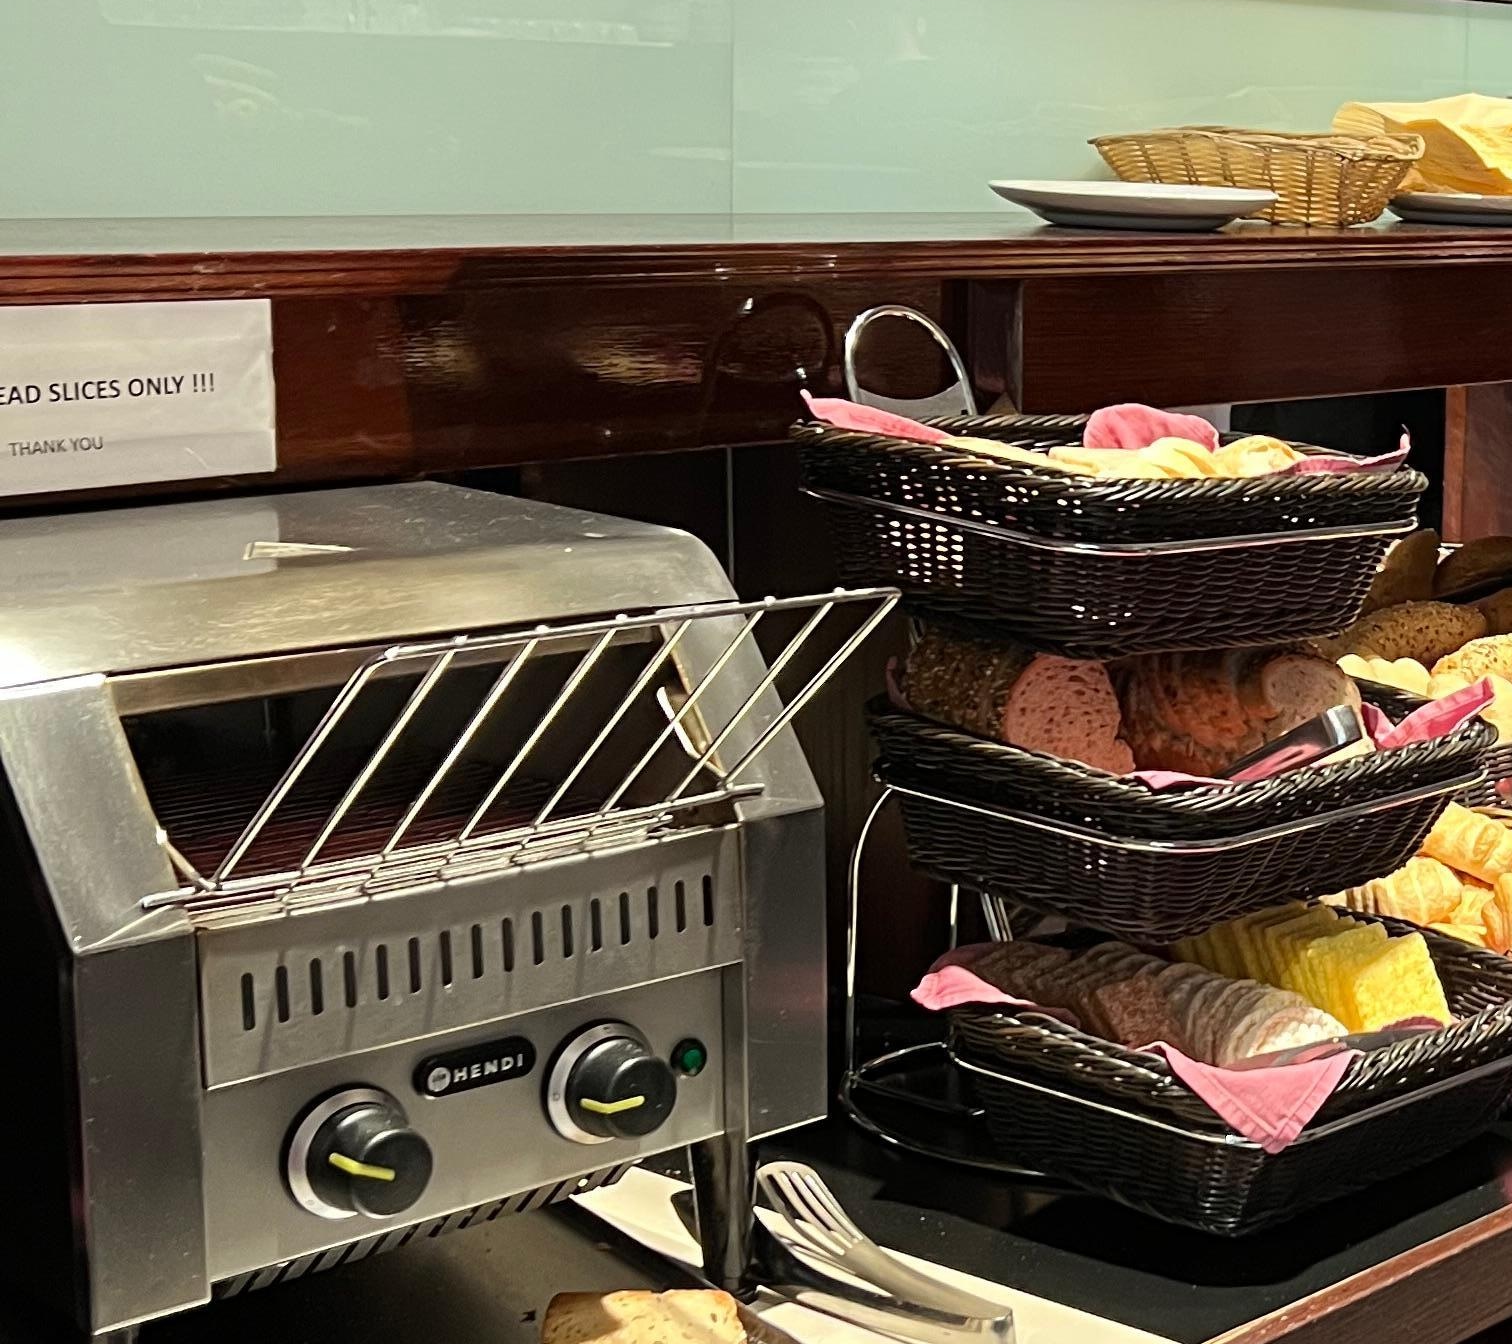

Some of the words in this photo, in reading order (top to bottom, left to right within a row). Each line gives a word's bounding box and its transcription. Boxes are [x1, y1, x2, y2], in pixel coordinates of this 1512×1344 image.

[49, 379, 121, 403] SLICES
[128, 375, 185, 397] ONLY
[192, 372, 215, 393] !!!
[8, 439, 67, 457] THANK
[70, 436, 103, 452] YOU
[453, 1053, 524, 1083] HENDI
